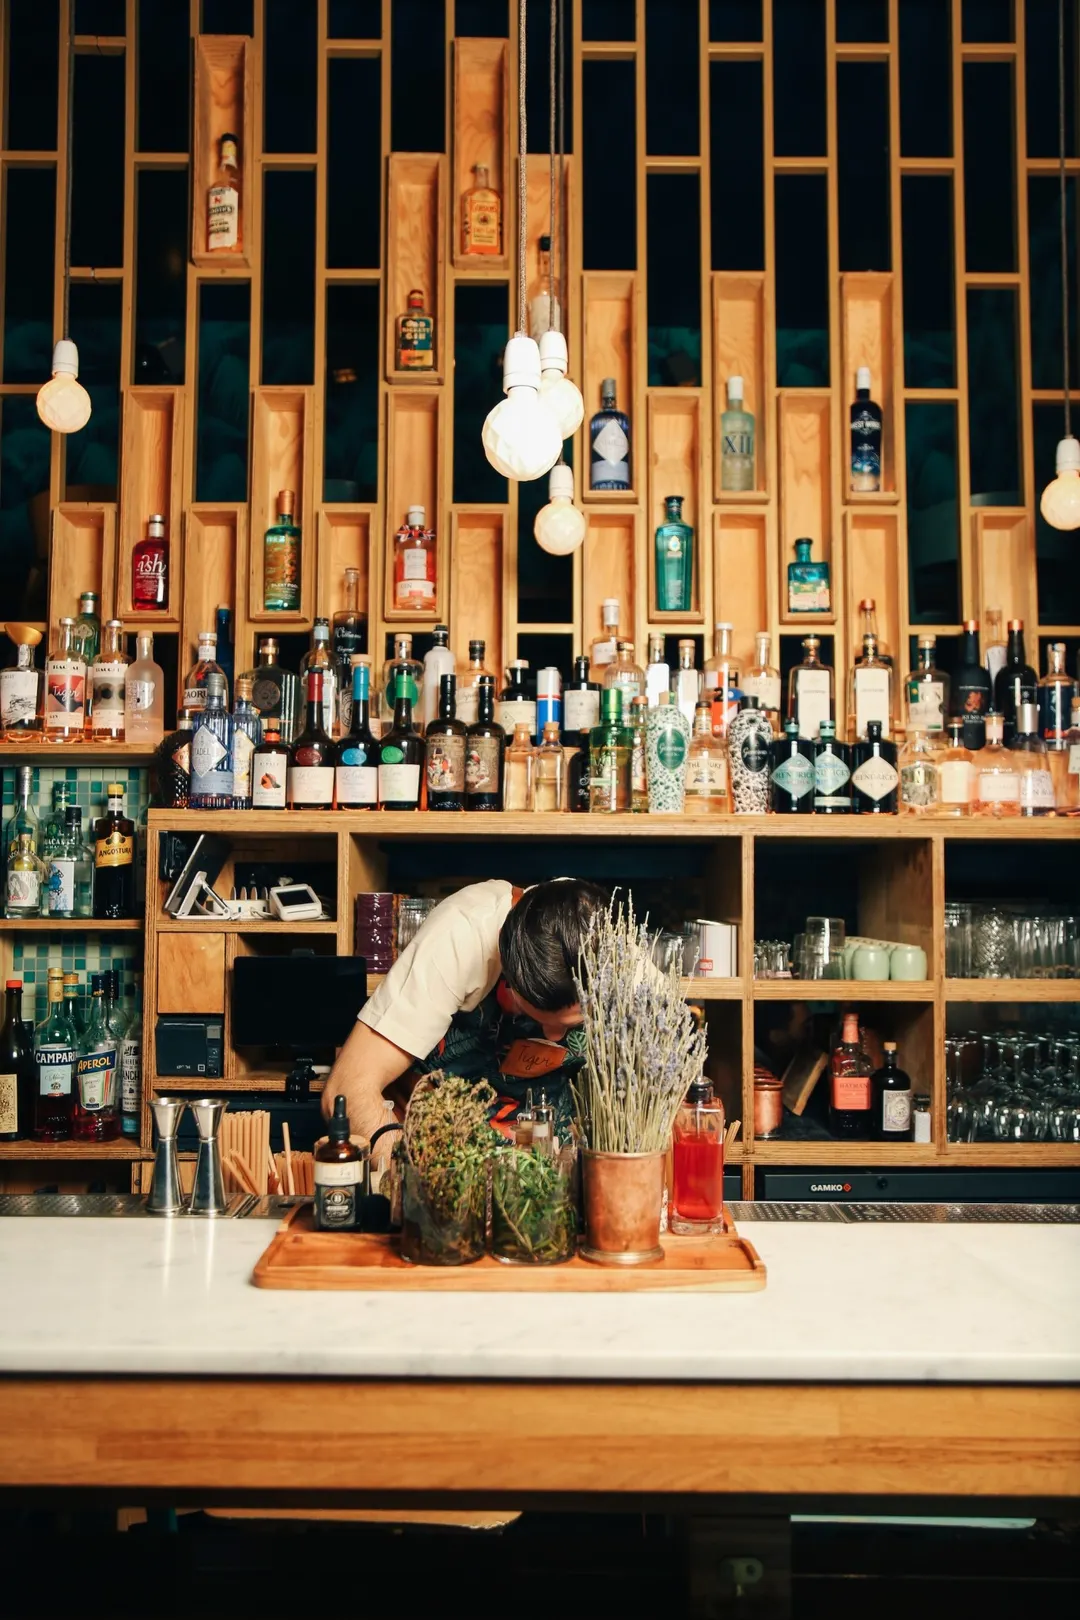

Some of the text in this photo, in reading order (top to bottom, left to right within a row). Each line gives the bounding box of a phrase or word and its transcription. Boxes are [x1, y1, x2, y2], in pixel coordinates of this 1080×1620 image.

[724, 434, 752, 455] XII
[53, 685, 80, 700] Tiger
[99, 846, 132, 858] ANGOSTURA
[77, 1056, 112, 1072] APEROL
[518, 1045, 551, 1071] Tiger
[811, 1183, 843, 1192] GAMKO
